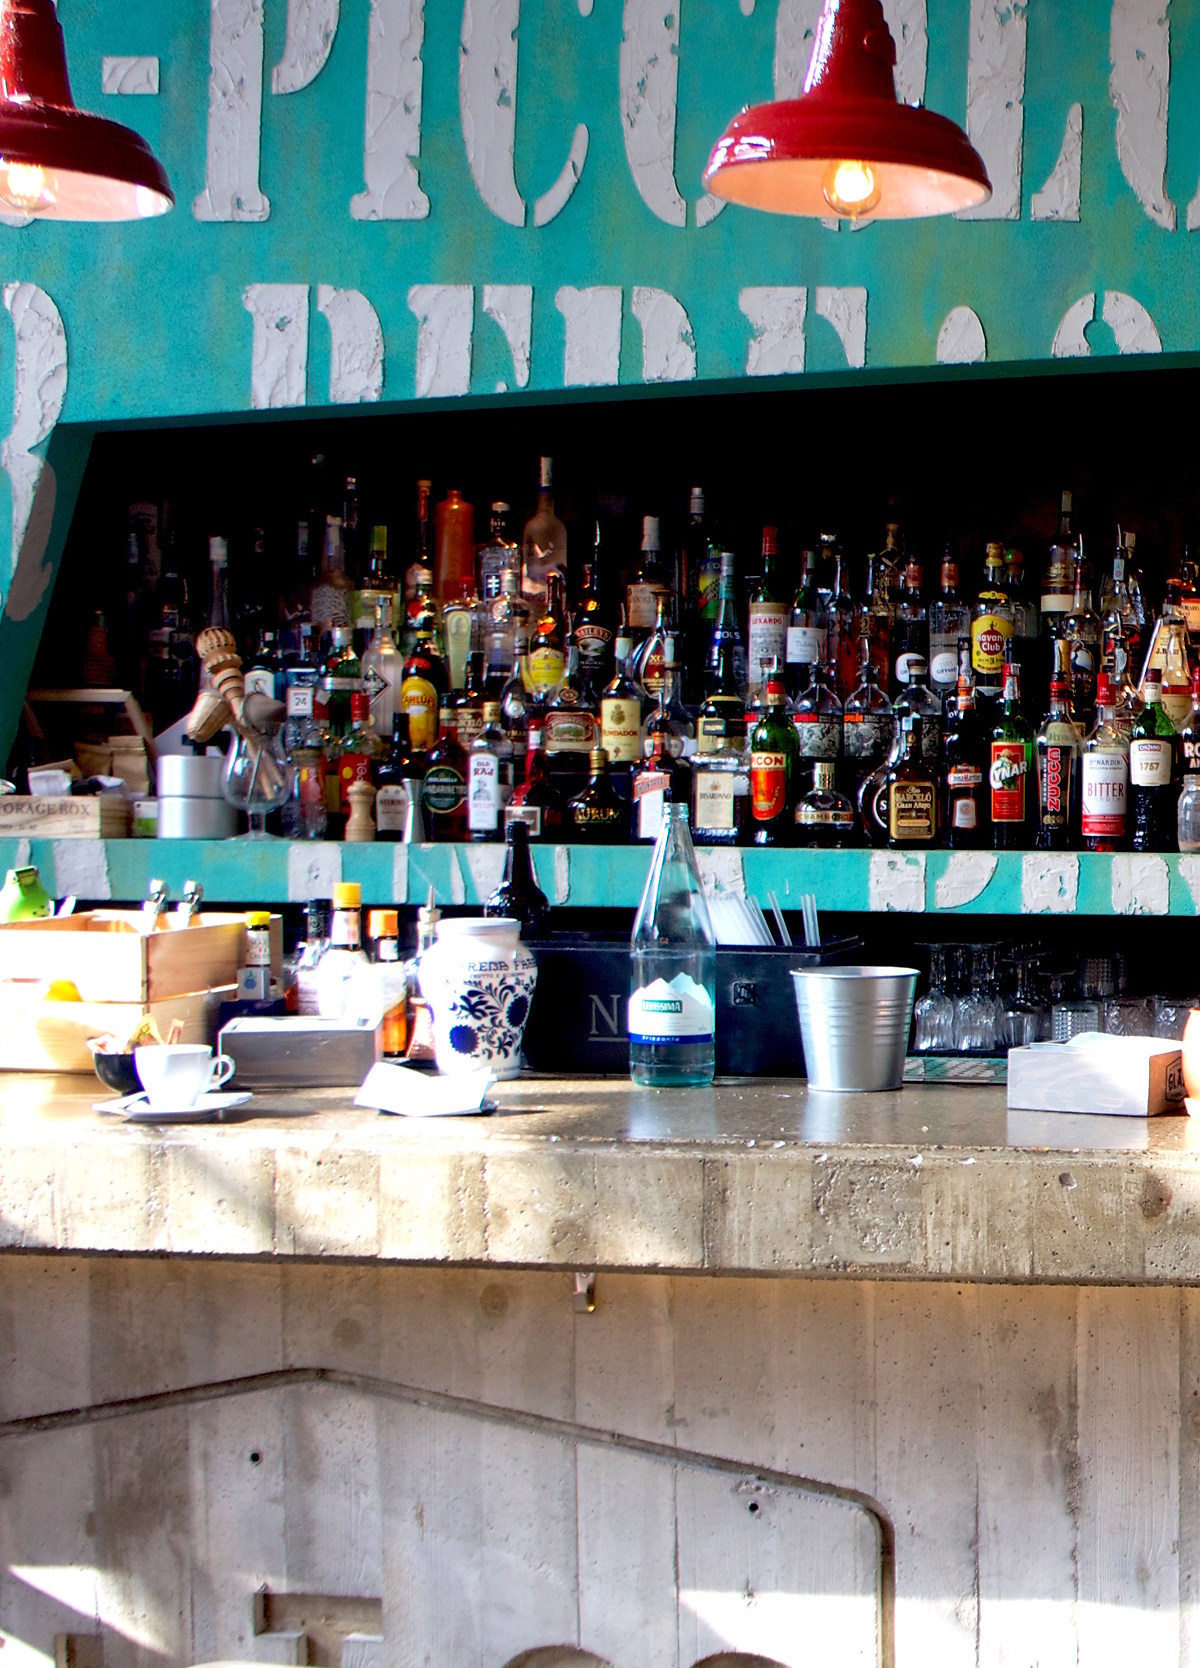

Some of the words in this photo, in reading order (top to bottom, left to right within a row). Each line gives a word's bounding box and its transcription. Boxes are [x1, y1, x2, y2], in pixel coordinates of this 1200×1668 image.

[982, 642, 1001, 652] Club
[295, 697, 307, 707] 24
[1140, 762, 1160, 771] 1757
[990, 757, 1028, 790] CYNAR
[1047, 747, 1061, 812] ZUCCA
[1087, 782, 1124, 797] BITTER
[60, 803, 90, 816] BOX
